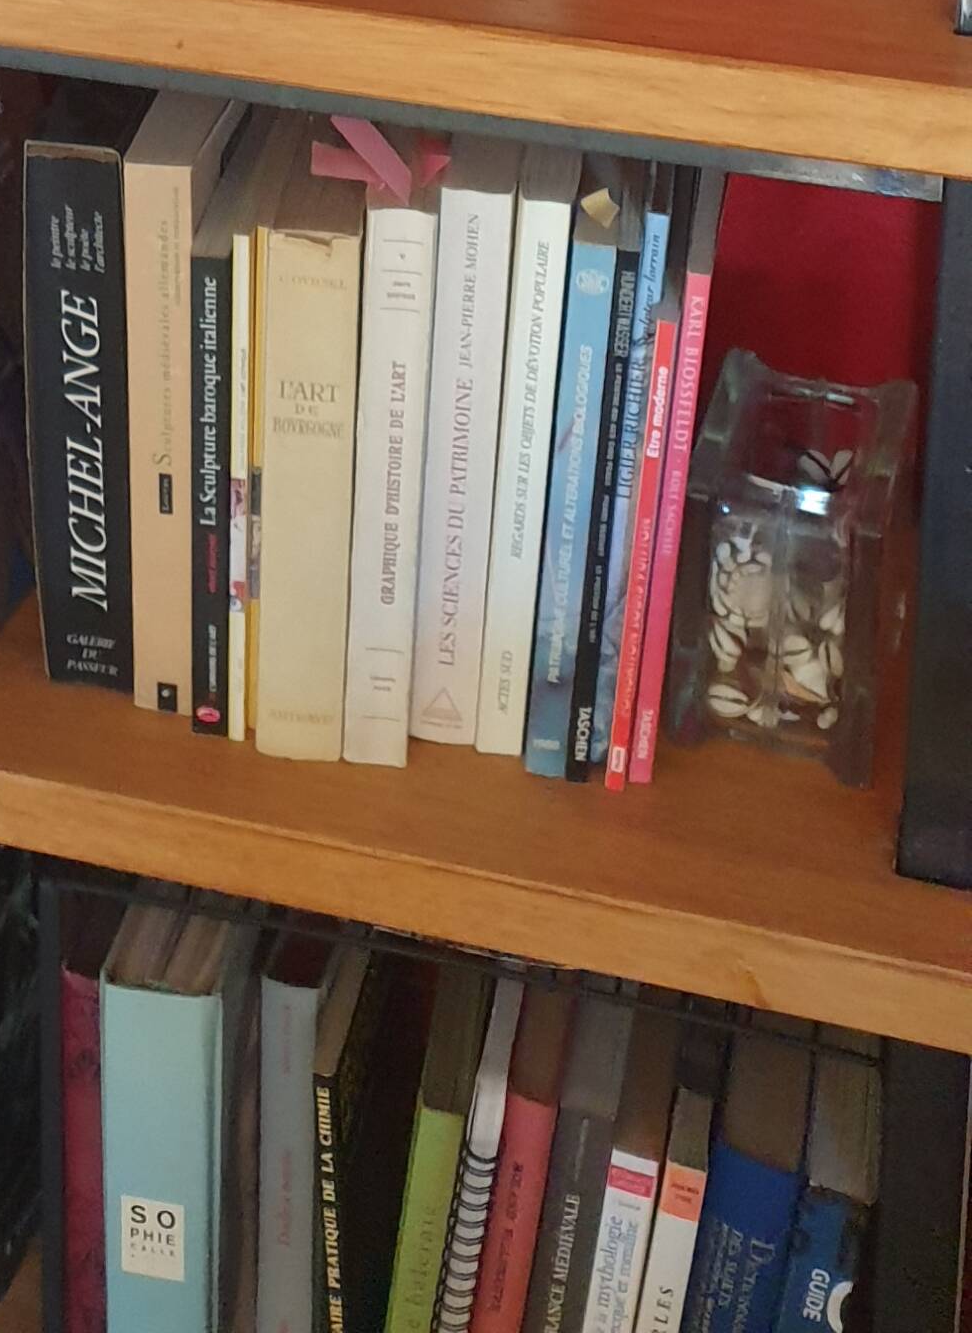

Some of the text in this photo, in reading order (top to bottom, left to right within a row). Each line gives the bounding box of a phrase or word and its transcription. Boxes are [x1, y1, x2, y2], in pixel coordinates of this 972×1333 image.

[50, 215, 63, 269] le peintre
[64, 204, 77, 270] le sculpteur
[199, 277, 217, 351] italienne
[200, 353, 221, 423] baroque
[279, 380, 341, 403] L'ART
[510, 240, 550, 559] REGARDS SUR LES OBJETS DE DÉVOTION POPULAIRE
[616, 438, 637, 501] LIGIER
[640, 233, 661, 282] lorrain
[673, 295, 705, 453] KARL BLOSSFELDT
[152, 387, 173, 468] Sculptures
[294, 403, 319, 417] DE
[437, 213, 480, 667] LES SCIENCES DU PATRIMOINE JEAN-PIERRE MOHEN
[645, 365, 668, 459] Etre moderne
[61, 289, 109, 612] MICHEL-ANGE
[200, 426, 221, 504] Sculpture
[380, 361, 407, 606] GRAPHIQUE D'HISTOIRE DE L'ART
[200, 507, 216, 526] La
[496, 651, 514, 715] ACTES SUD
[573, 707, 593, 762] TASCHEN
[637, 708, 655, 760] TASCHEN
[316, 1086, 331, 1146] CHIMIE
[320, 1152, 334, 1172] LA
[322, 1180, 335, 1201] DE
[130, 1227, 176, 1246] PHIE
[322, 1204, 340, 1289] PRATIQUE
[595, 1216, 623, 1308] mythologie
[802, 1268, 831, 1322] GUIDE
